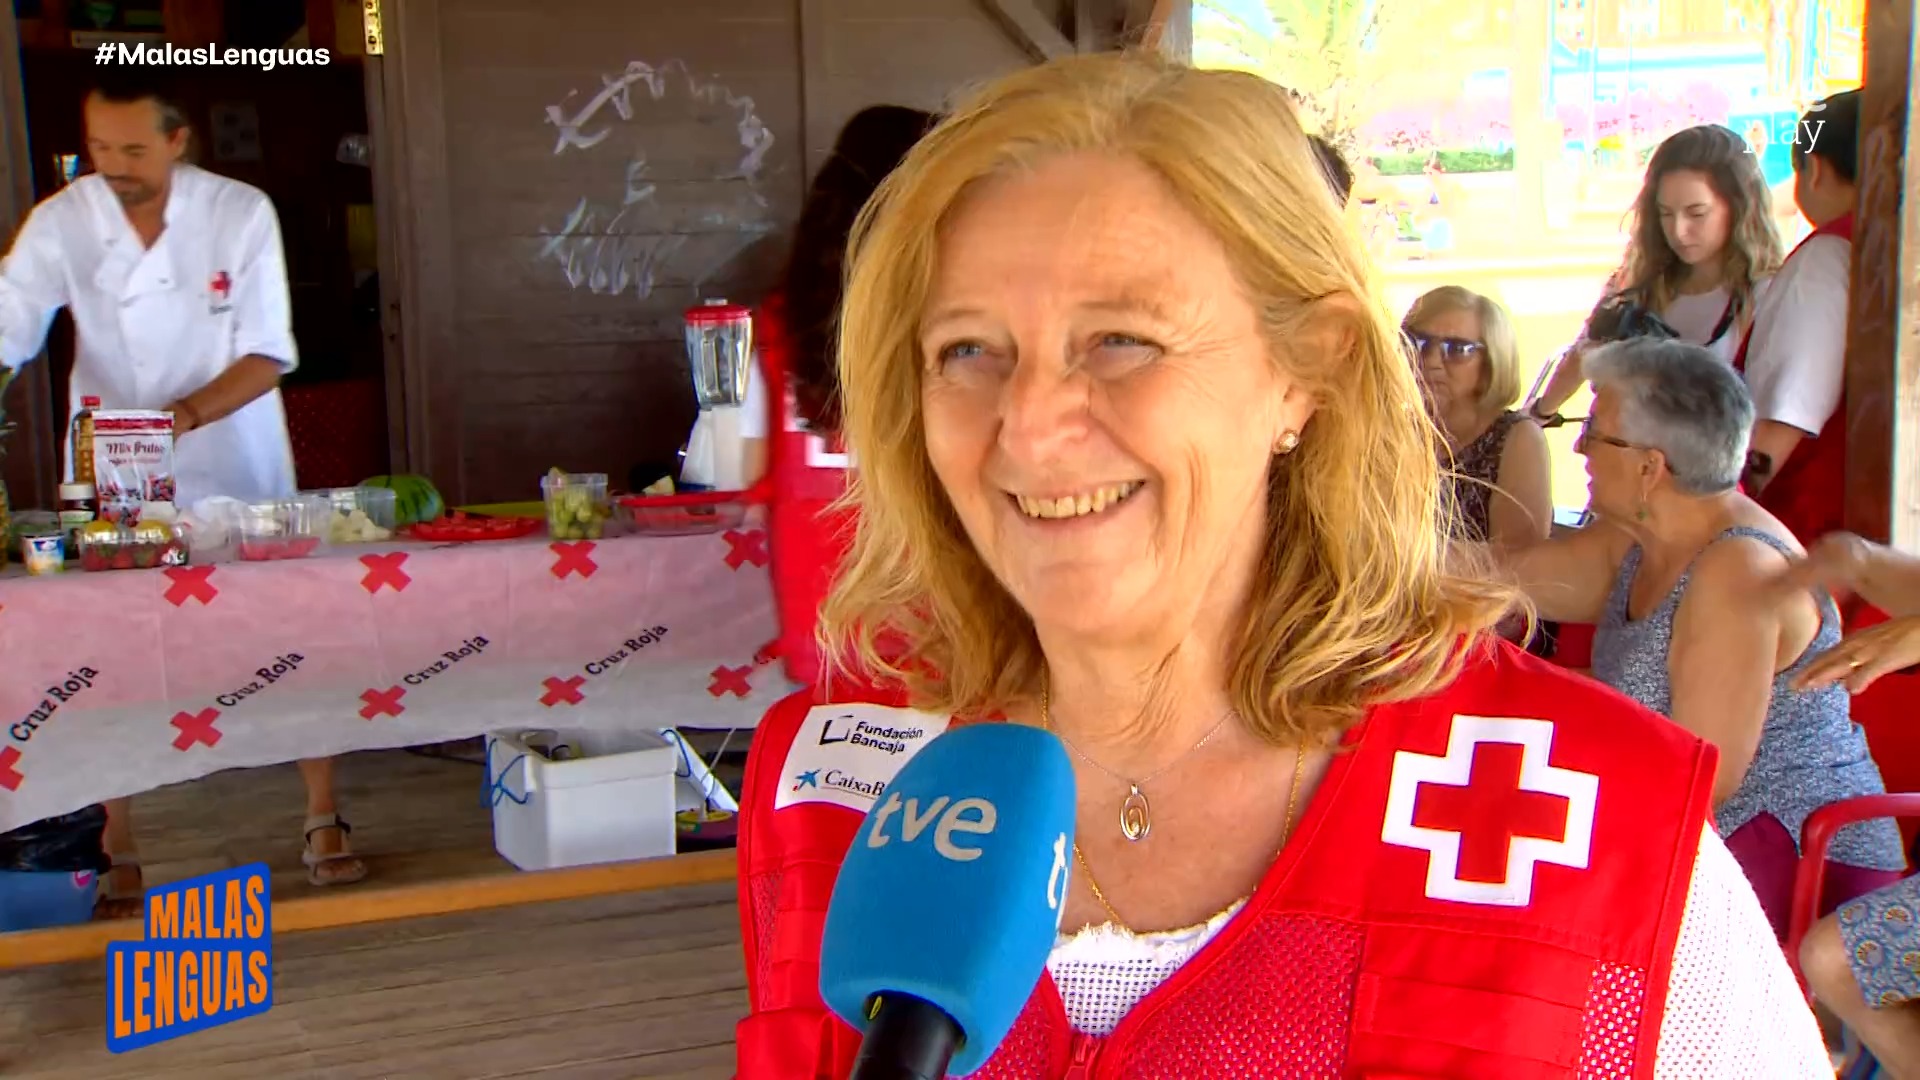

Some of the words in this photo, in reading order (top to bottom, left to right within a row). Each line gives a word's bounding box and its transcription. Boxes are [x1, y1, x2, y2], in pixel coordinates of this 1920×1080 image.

[404, 660, 448, 685] Cruz
[444, 634, 489, 663] Roja
[585, 648, 628, 676] Cruz
[624, 623, 668, 653] Roja
[9, 698, 57, 743] Cruz
[47, 664, 99, 703] Roja
[217, 681, 264, 707] Cruz
[256, 650, 304, 684] Roja
[850, 733, 905, 755] Bancaja
[856, 721, 923, 739] Fundación
[825, 769, 886, 796] CaixaB
[867, 792, 997, 862] tve
